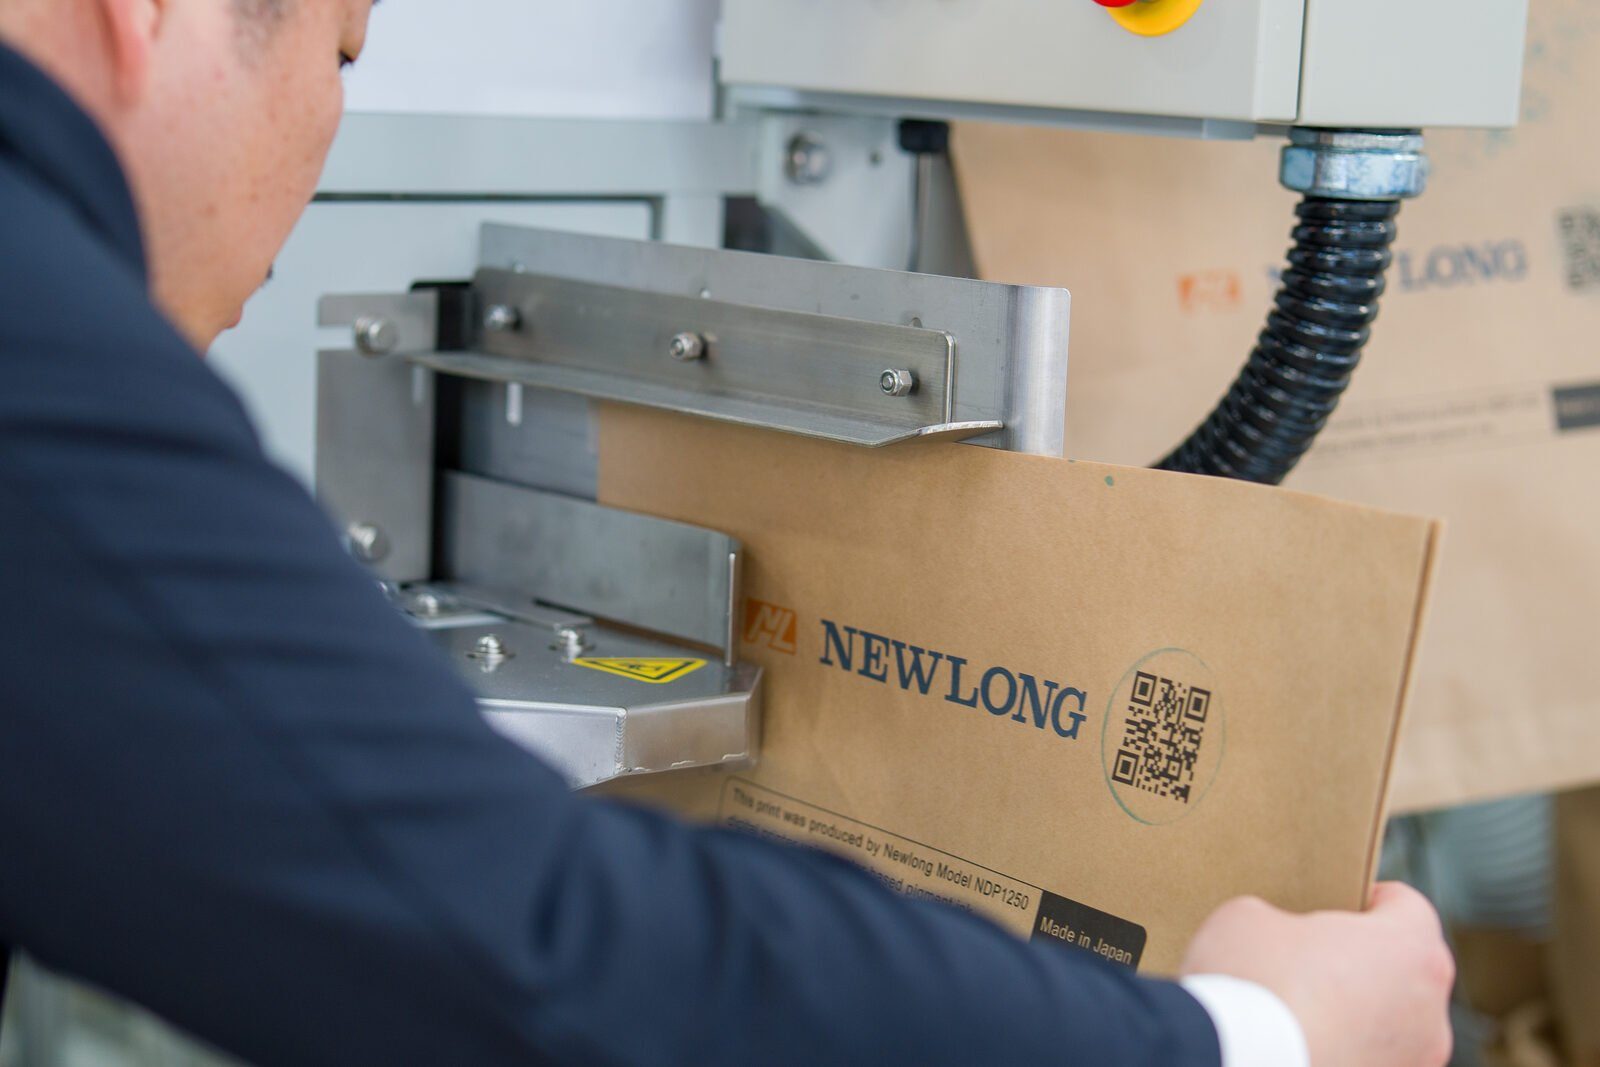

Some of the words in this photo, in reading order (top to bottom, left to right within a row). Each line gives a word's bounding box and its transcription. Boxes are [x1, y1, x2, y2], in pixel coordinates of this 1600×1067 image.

[819, 619, 1087, 740] NEWLONG
[756, 800, 781, 819] print
[783, 811, 806, 828] was
[808, 820, 863, 848] produced
[866, 838, 881, 856] by
[883, 842, 934, 876] Newlong
[936, 862, 972, 888] Model
[974, 877, 1029, 910] NDP1250
[1040, 916, 1076, 943] Made
[1078, 930, 1091, 949] in
[1093, 937, 1132, 965] Japan
